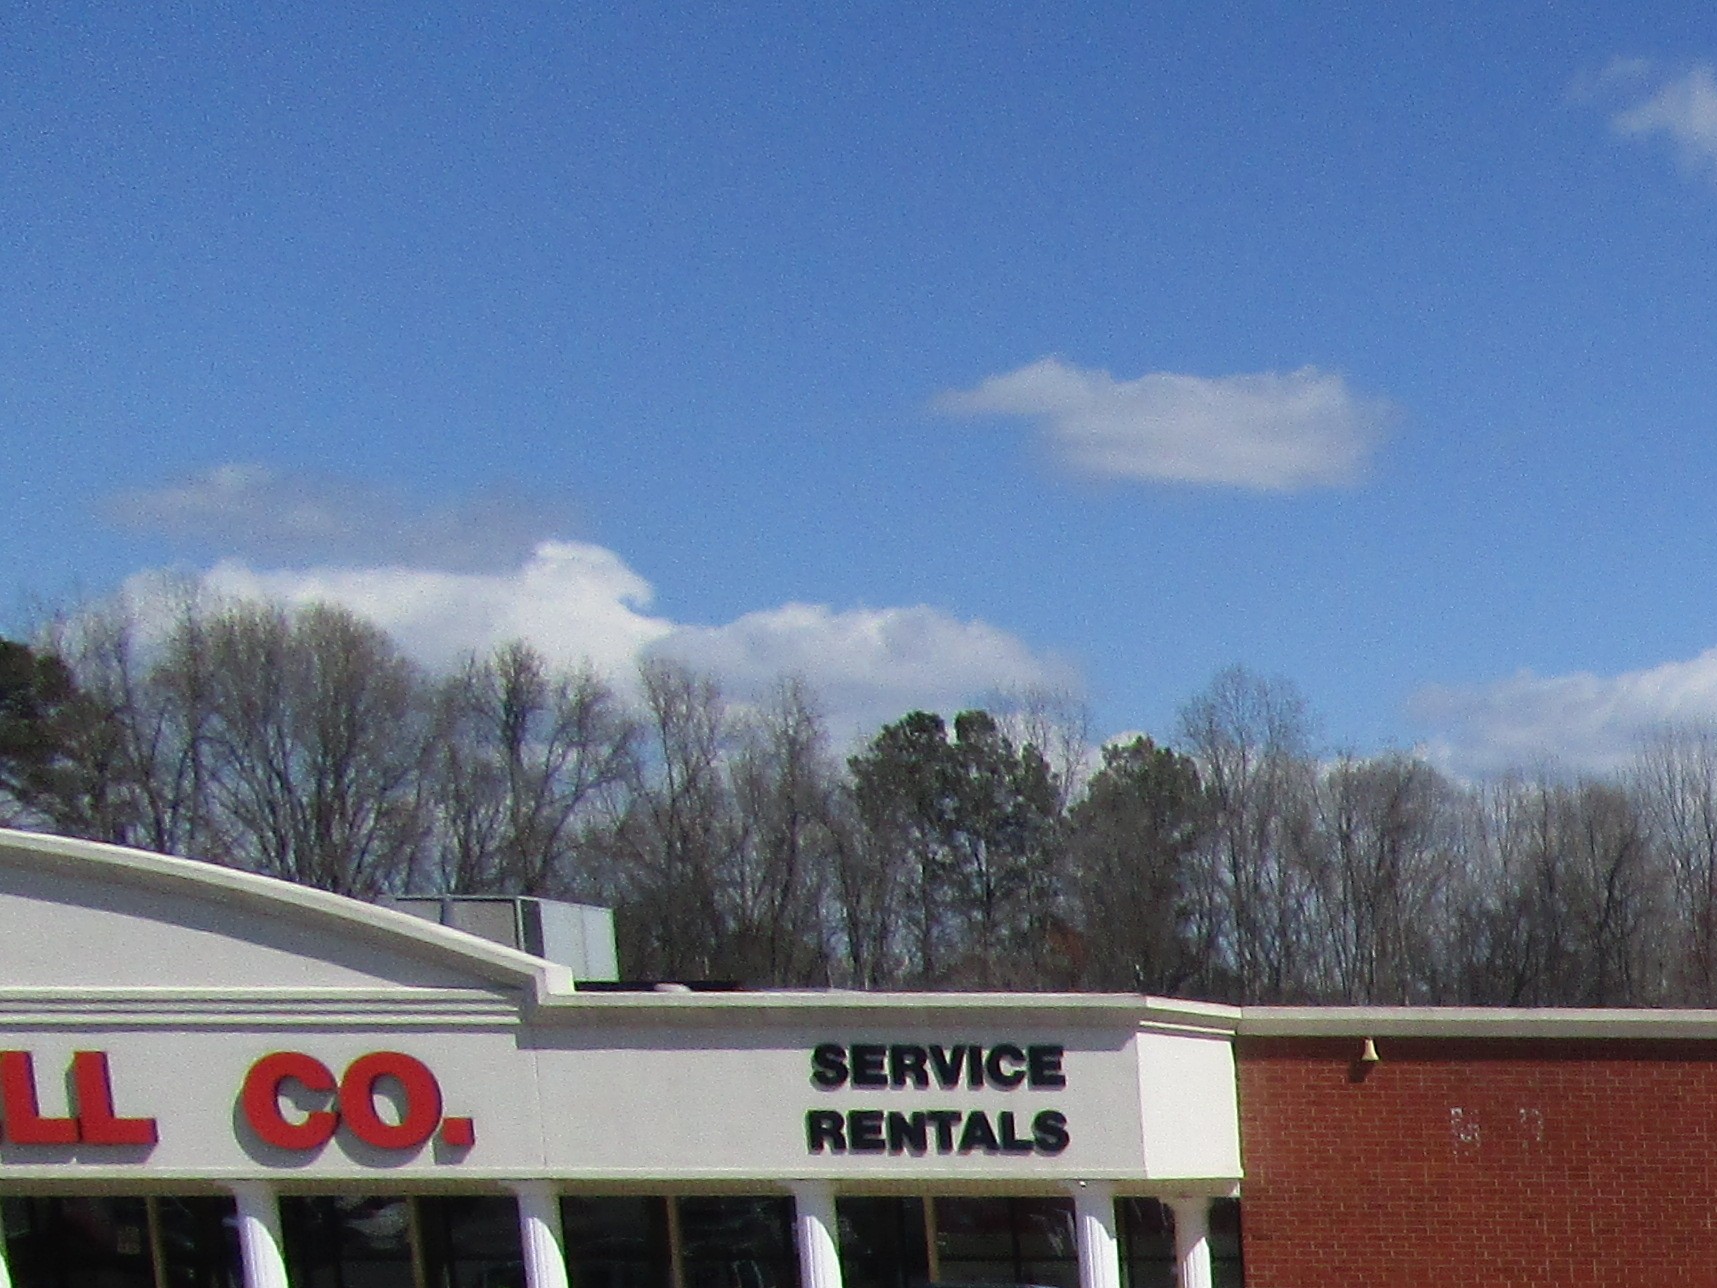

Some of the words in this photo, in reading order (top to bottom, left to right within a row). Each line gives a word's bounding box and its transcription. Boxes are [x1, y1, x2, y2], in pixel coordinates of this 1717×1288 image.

[809, 1043, 1067, 1091] SERVICE
[243, 1051, 476, 1150] CO.
[805, 1110, 1071, 1156] RENTALS
